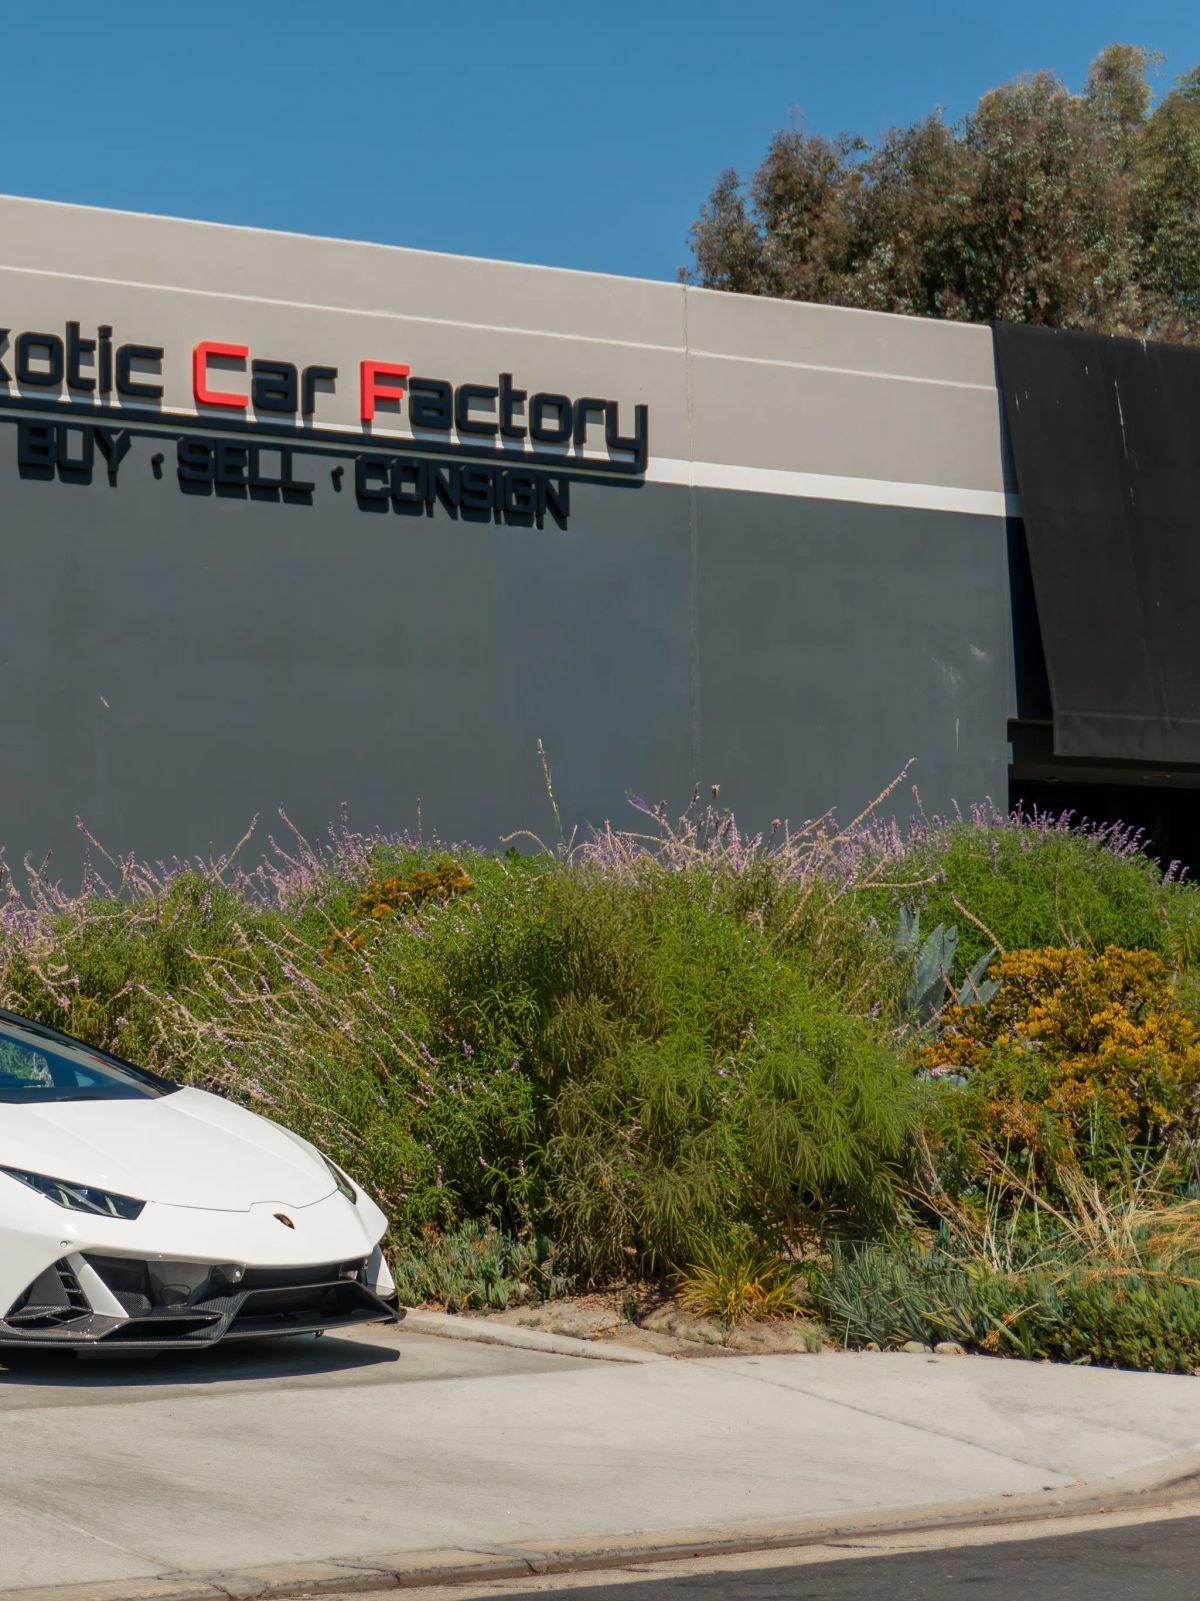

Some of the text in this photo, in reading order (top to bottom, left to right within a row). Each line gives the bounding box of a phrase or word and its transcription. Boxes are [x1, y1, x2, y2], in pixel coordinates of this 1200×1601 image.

[193, 341, 338, 415] Car
[360, 360, 649, 474] Factory
[17, 420, 570, 518] BUY SELL CONSIGN
